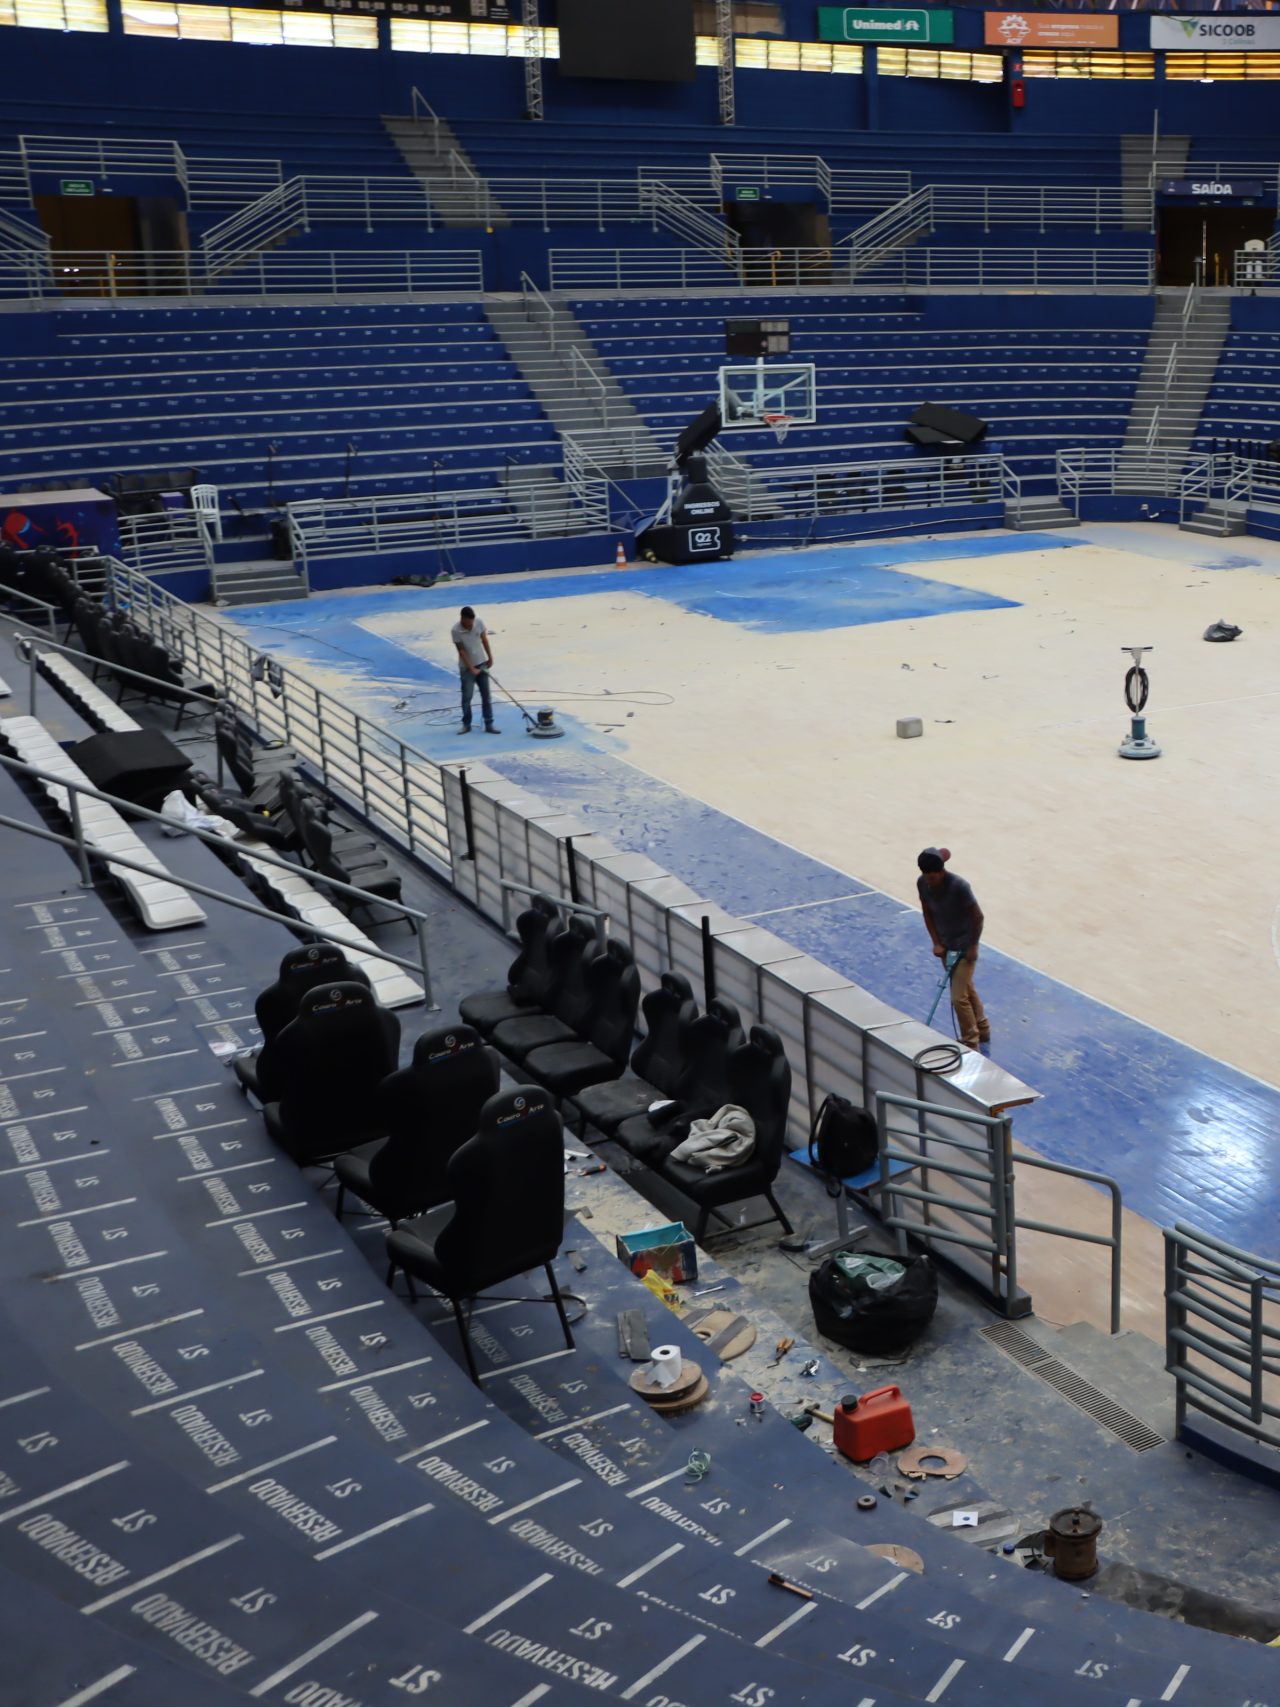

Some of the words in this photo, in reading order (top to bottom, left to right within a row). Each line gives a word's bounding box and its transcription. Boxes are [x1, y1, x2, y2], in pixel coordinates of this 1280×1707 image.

[852, 19, 902, 31] Unimed
[1200, 24, 1256, 37] SICOOB
[1192, 181, 1233, 195] SAÍDA
[75, 1176, 100, 1188] ST
[248, 1182, 272, 1194] ST
[102, 1227, 129, 1240] ST
[232, 1222, 277, 1264] RESERVADO
[281, 1227, 305, 1240] ST
[48, 1221, 91, 1268] RESERVADO
[132, 1283, 160, 1297] ST
[265, 1272, 313, 1318] RESERVADO
[317, 1278, 342, 1291] ST
[75, 1276, 121, 1329] RESERVADO
[359, 1332, 387, 1347] ST
[177, 1344, 210, 1360] ST
[305, 1326, 359, 1377] RESERVADO
[112, 1340, 178, 1396] RESERVADO
[560, 1379, 588, 1394] ST
[408, 1392, 438, 1408] ST
[238, 1408, 272, 1427] ST
[350, 1385, 409, 1442] RESERVADO
[17, 1431, 59, 1453] ST
[170, 1405, 241, 1467] RESERVADO
[483, 1456, 517, 1474] ST
[325, 1477, 362, 1498] ST
[416, 1456, 504, 1513] RESERVADO
[248, 1478, 343, 1543] RESERVADO
[699, 1497, 731, 1515] ST
[111, 1508, 158, 1533] ST
[579, 1518, 614, 1537] ST
[17, 1513, 131, 1586] RESERVADO
[805, 1555, 839, 1573] ST
[229, 1586, 278, 1613] ST
[698, 1583, 736, 1605] ST
[569, 1616, 613, 1641] ST
[926, 1611, 961, 1630] ST
[131, 1592, 256, 1675] RESERVADO
[837, 1644, 877, 1667] ST
[388, 1664, 442, 1694] ST
[1074, 1659, 1109, 1679] ST
[730, 1682, 776, 1707] ST
